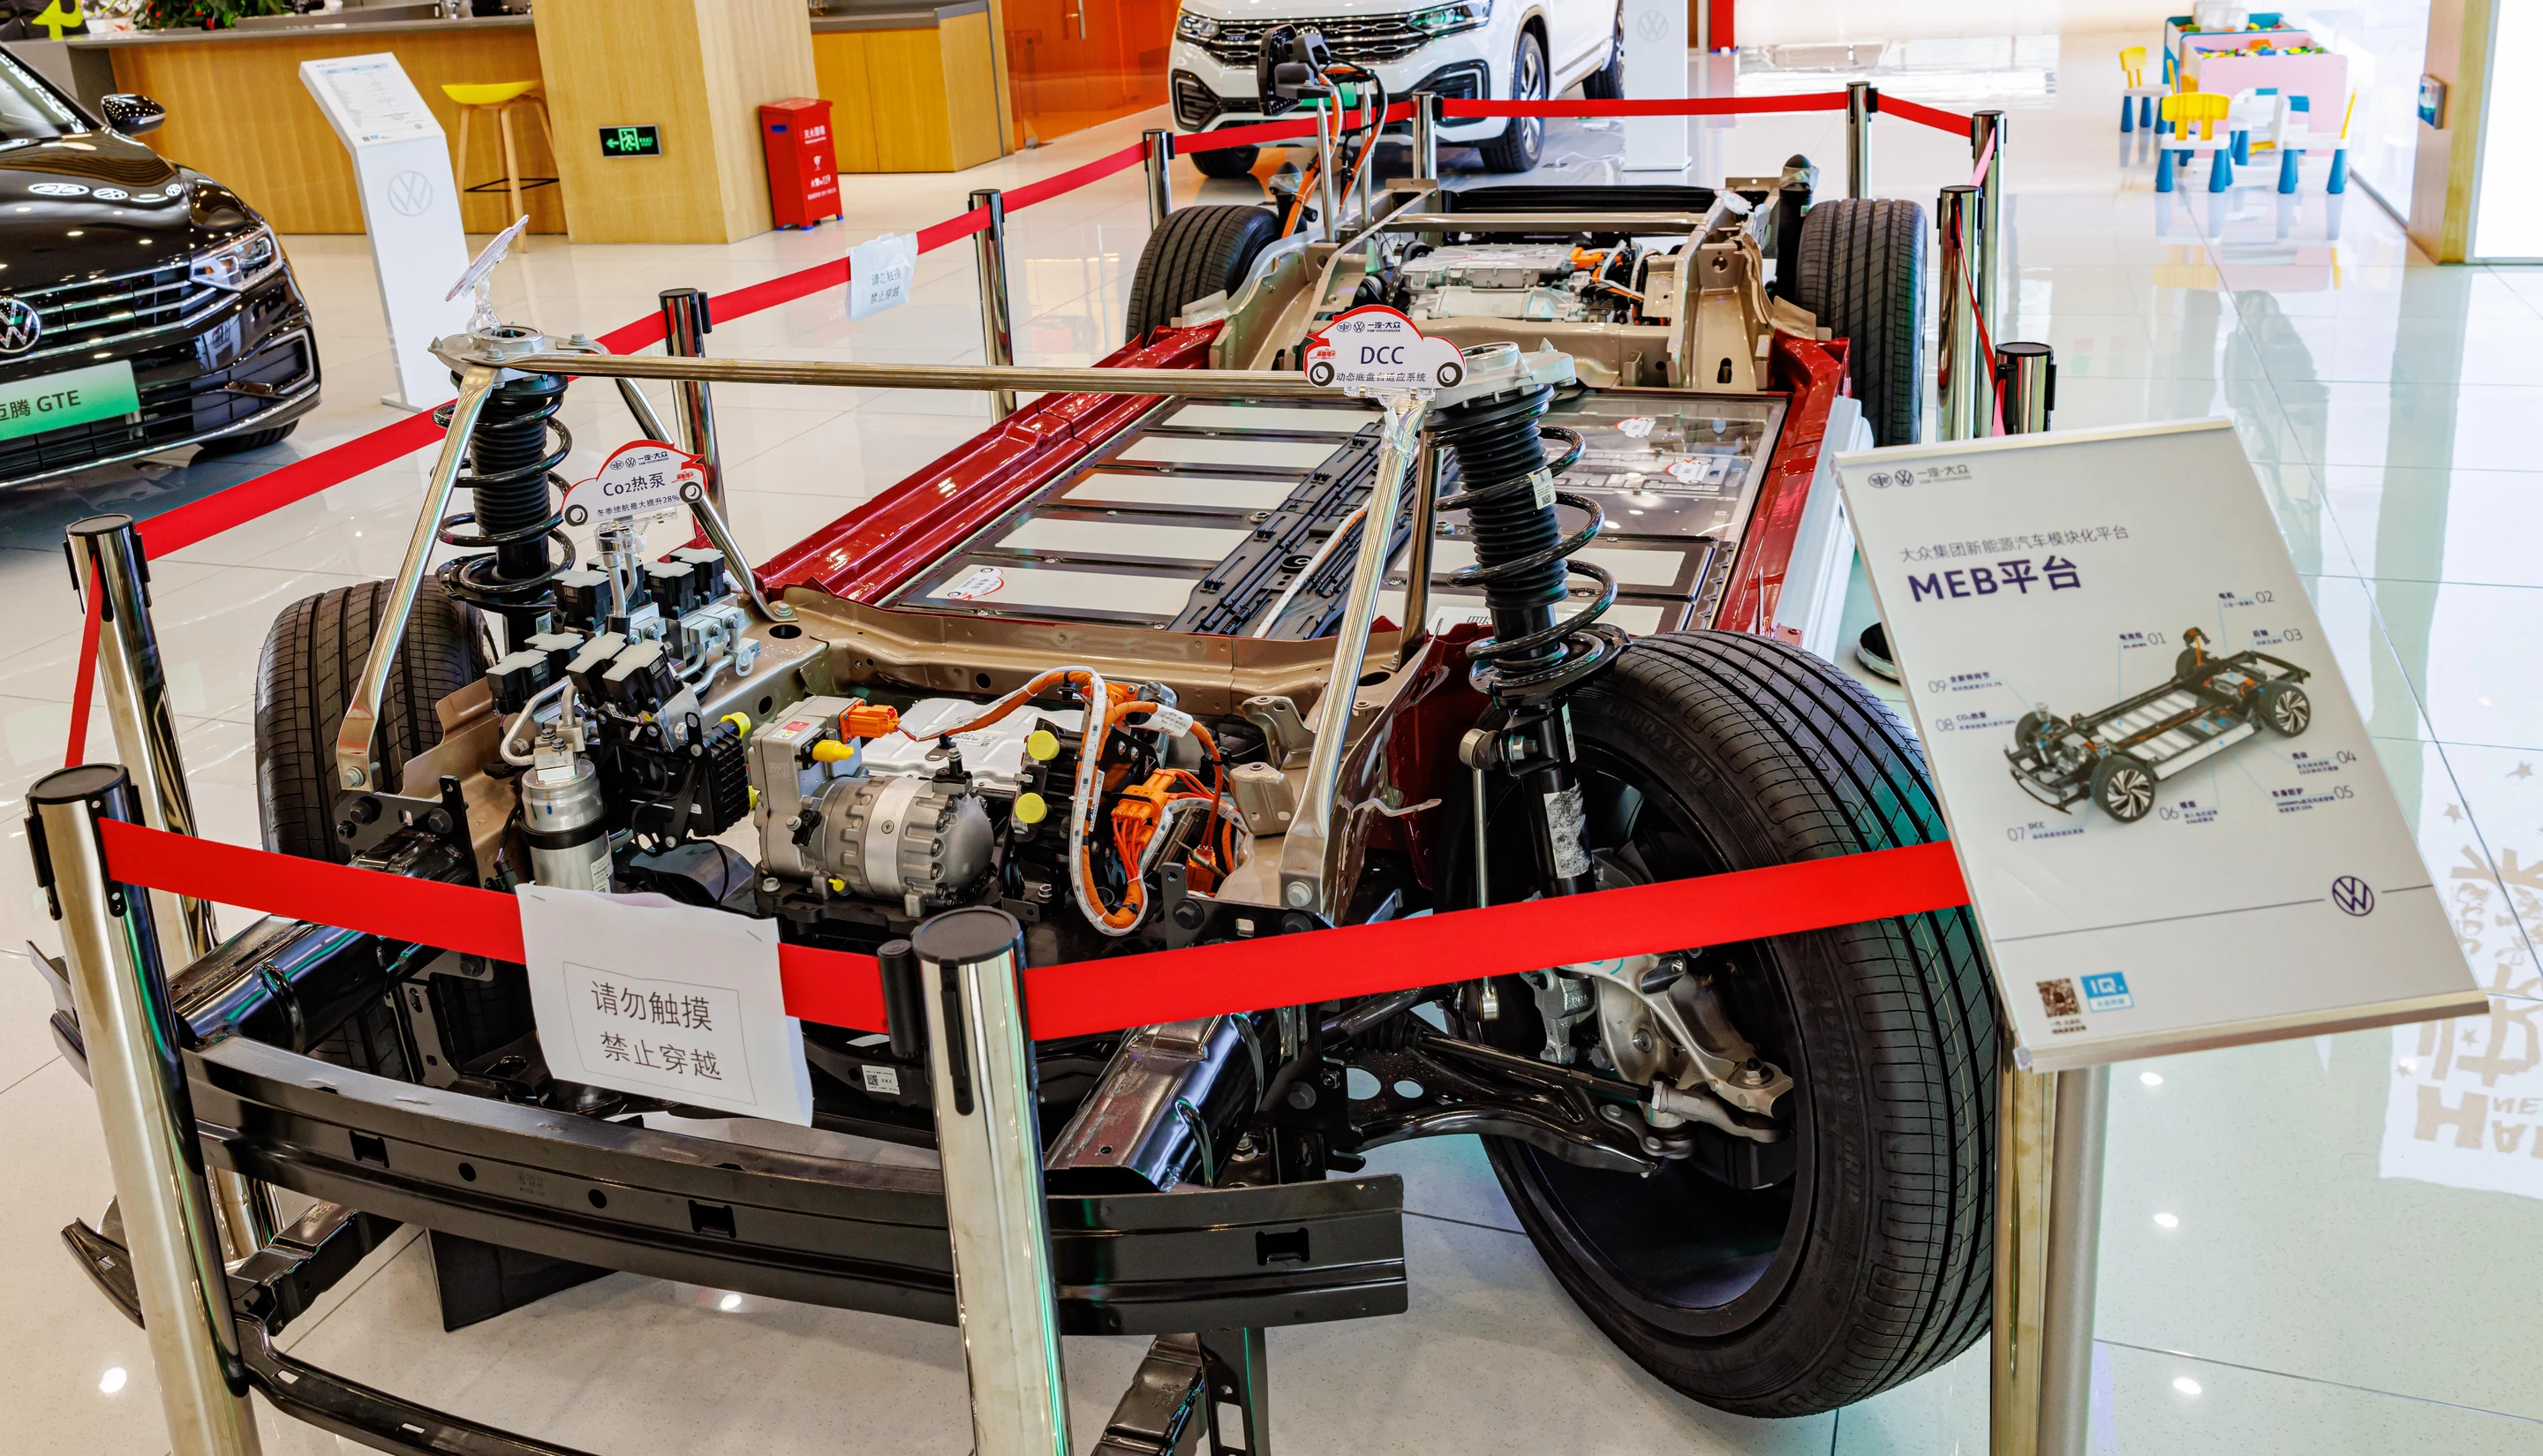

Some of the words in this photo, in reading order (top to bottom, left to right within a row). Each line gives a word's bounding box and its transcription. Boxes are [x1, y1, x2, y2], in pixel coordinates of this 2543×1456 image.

[871, 268, 902, 285] 请勿触摸
[870, 285, 900, 305] 禁止穿越
[1361, 346, 1405, 365] DCC
[1336, 372, 1427, 382] 动态底盘自适应系统
[36, 389, 81, 412] GTE
[597, 494, 680, 517] 冬季续航最大提升28%
[1898, 524, 2130, 563] 大众集团新能源汽车模块化平台
[1907, 554, 2082, 602] MEB平台
[2255, 591, 2275, 604] 02
[2147, 631, 2167, 646] 01
[2283, 628, 2304, 642] 03
[1928, 679, 1946, 694] 09
[1935, 718, 1955, 732] 08
[2336, 750, 2357, 764] 04
[2334, 784, 2355, 799] 05
[2159, 806, 2178, 821] 06
[2006, 826, 2026, 841] 07
[2027, 820, 2046, 830] DCC
[591, 980, 713, 1031] 请勿触摸
[600, 1030, 722, 1081] 禁止穿越
